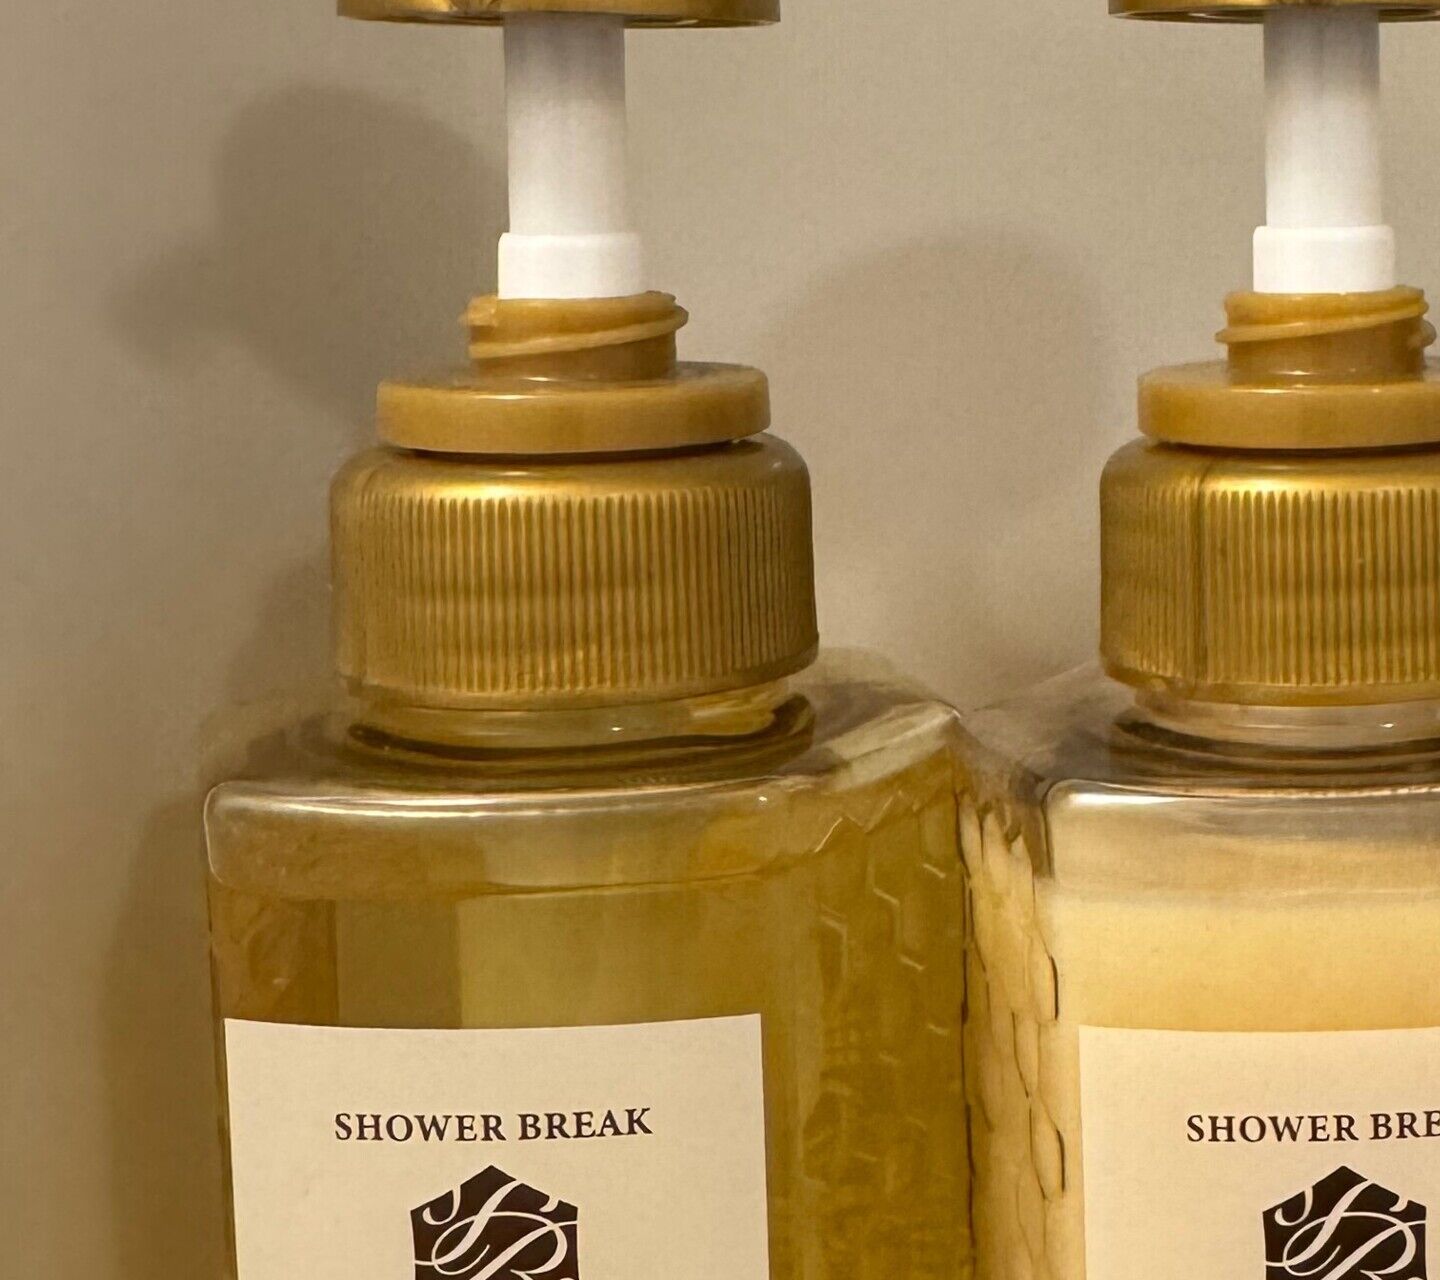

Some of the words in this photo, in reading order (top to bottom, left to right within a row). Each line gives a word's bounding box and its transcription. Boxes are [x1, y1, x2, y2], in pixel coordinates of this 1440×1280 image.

[334, 1112, 507, 1143] SHOWER
[517, 1107, 653, 1141] BREAK
[1187, 1114, 1360, 1143] SHOWER
